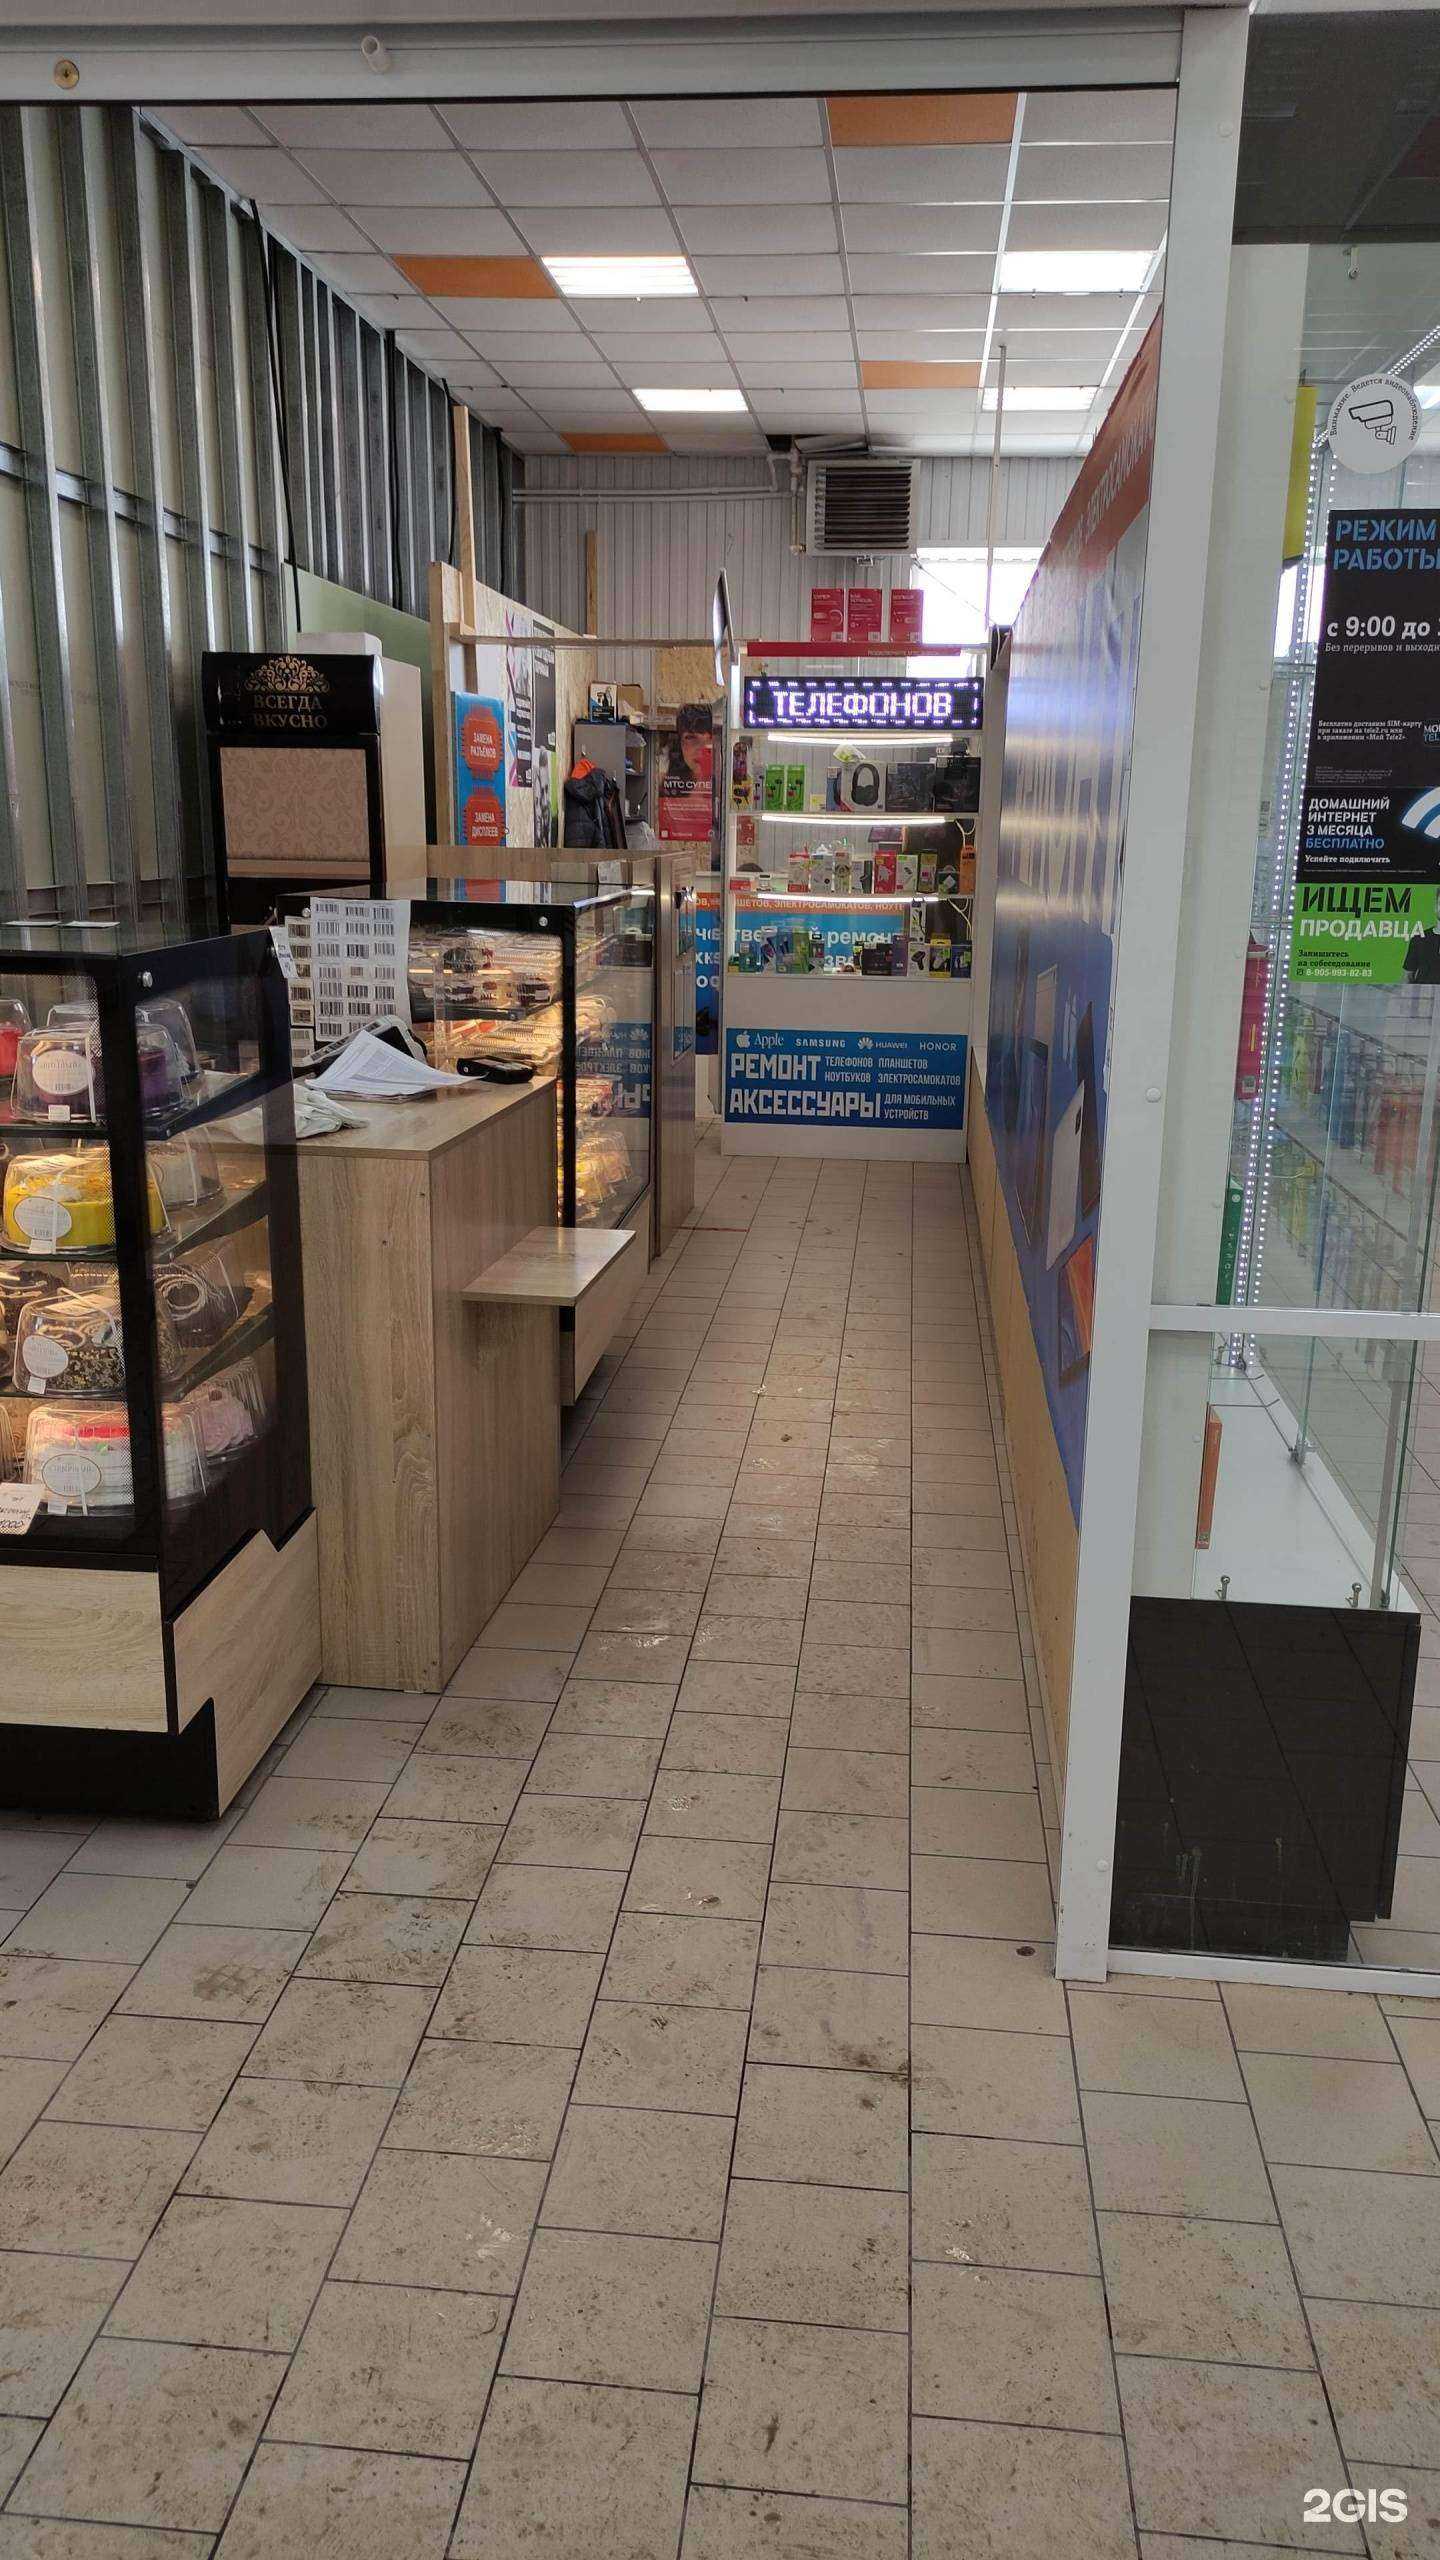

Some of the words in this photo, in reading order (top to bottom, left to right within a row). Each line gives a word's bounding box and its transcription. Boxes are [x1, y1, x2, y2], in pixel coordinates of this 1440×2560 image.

[1335, 519, 1437, 541] РЕЖИМ
[1333, 548, 1440, 570] РАБОТЫ
[1327, 622, 1338, 637] с
[1345, 615, 1396, 637] 9:00
[1401, 622, 1431, 639] до
[1325, 643, 1341, 652] Без
[1343, 643, 1393, 654] перерывов
[1396, 644, 1403, 652] и
[254, 695, 323, 712] ВСЕГДА
[773, 691, 953, 717] ТЕЛЕФОНОВ
[255, 714, 328, 728] ВКУСНО
[473, 732, 493, 744] ЗАМЕНА
[1424, 734, 1440, 742] TEL
[686, 781, 712, 789] СУПЕ
[1309, 797, 1390, 810] ДОМАШНИЙ
[474, 812, 495, 822] ЗАМЕНА
[1308, 812, 1377, 822] ИНТЕРНЕТ
[1307, 825, 1315, 835] 3
[1317, 825, 1373, 837] МЕСЯЦА
[1306, 838, 1385, 849] БЕСПЛАТНО
[1305, 854, 1338, 863] Успейте
[1339, 856, 1391, 864] подключить
[1301, 886, 1412, 918] ИЩЕМ
[1299, 919, 1426, 941] ПРОДАВЦА
[1298, 949, 1349, 958] Запишитесь
[1309, 959, 1371, 968] собеседование
[754, 1032, 785, 1048] Apple
[795, 1038, 846, 1048] SAMSUNG
[875, 1041, 908, 1049] HUAWEI
[919, 1041, 957, 1051] HONOR
[731, 1053, 821, 1081] РЕМОНТ
[825, 1056, 874, 1068] ТЕЛЕФОНОВ
[878, 1058, 928, 1070] ПЛАНШЕТОВ
[824, 1071, 871, 1083] НОУТБУКОВ
[878, 1073, 961, 1086] ЭЛЕКТРОСАМОКАТОВ
[729, 1088, 881, 1118] АКСЕССУАРЫ
[884, 1093, 902, 1105] ДЛЯ
[903, 1094, 956, 1106] МОБИЛЬНЫХ
[884, 1108, 929, 1120] УСТРОЙСТВ
